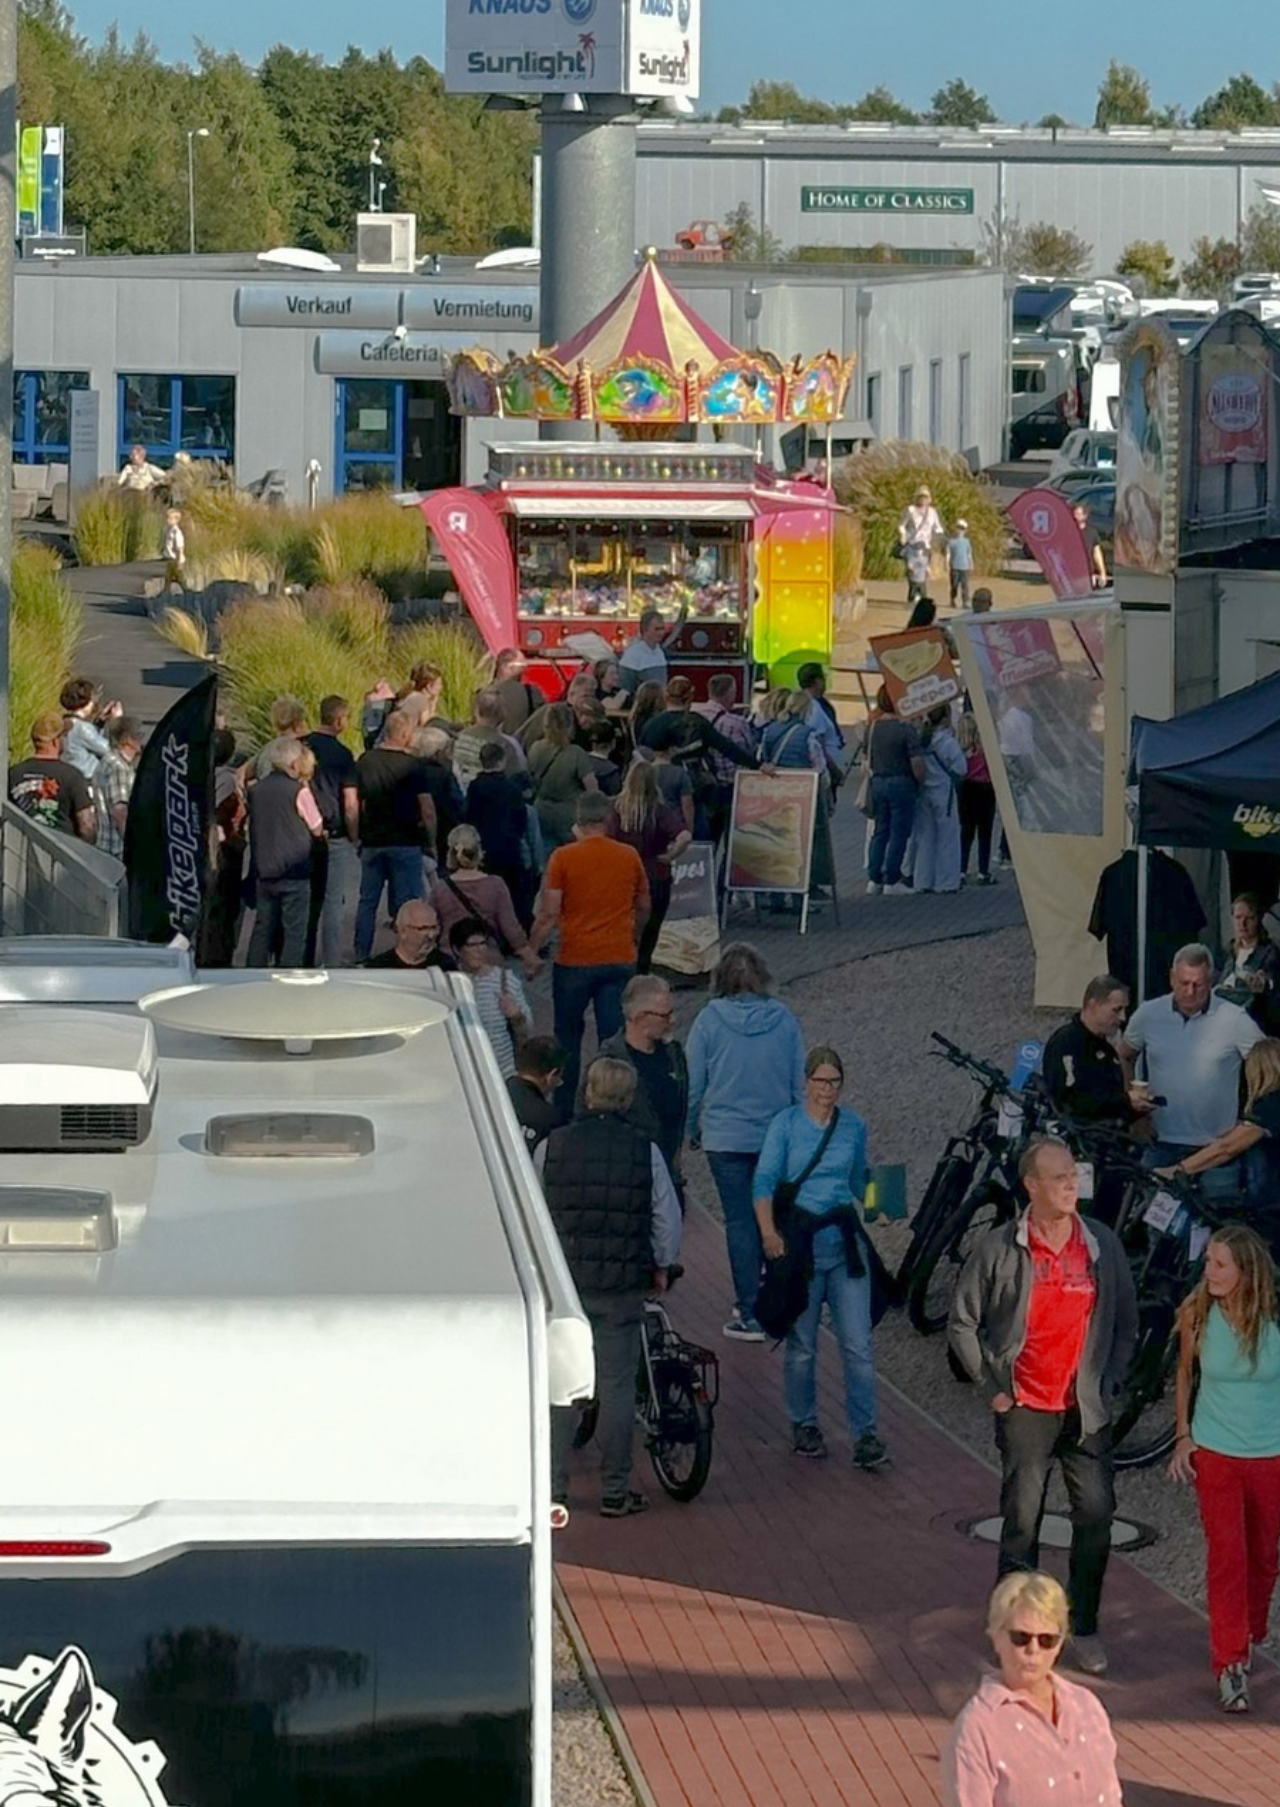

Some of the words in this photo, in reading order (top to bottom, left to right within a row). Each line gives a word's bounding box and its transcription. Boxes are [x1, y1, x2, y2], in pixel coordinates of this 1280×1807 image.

[468, 51, 586, 80] Sunlight
[639, 52, 686, 83] Sunlight
[809, 191, 858, 207] HOME
[864, 193, 887, 207] OF
[890, 193, 967, 208] CLASSICS
[286, 295, 353, 315] Verkauf
[433, 298, 533, 322] Vermietung
[360, 342, 438, 362] Cafeteria
